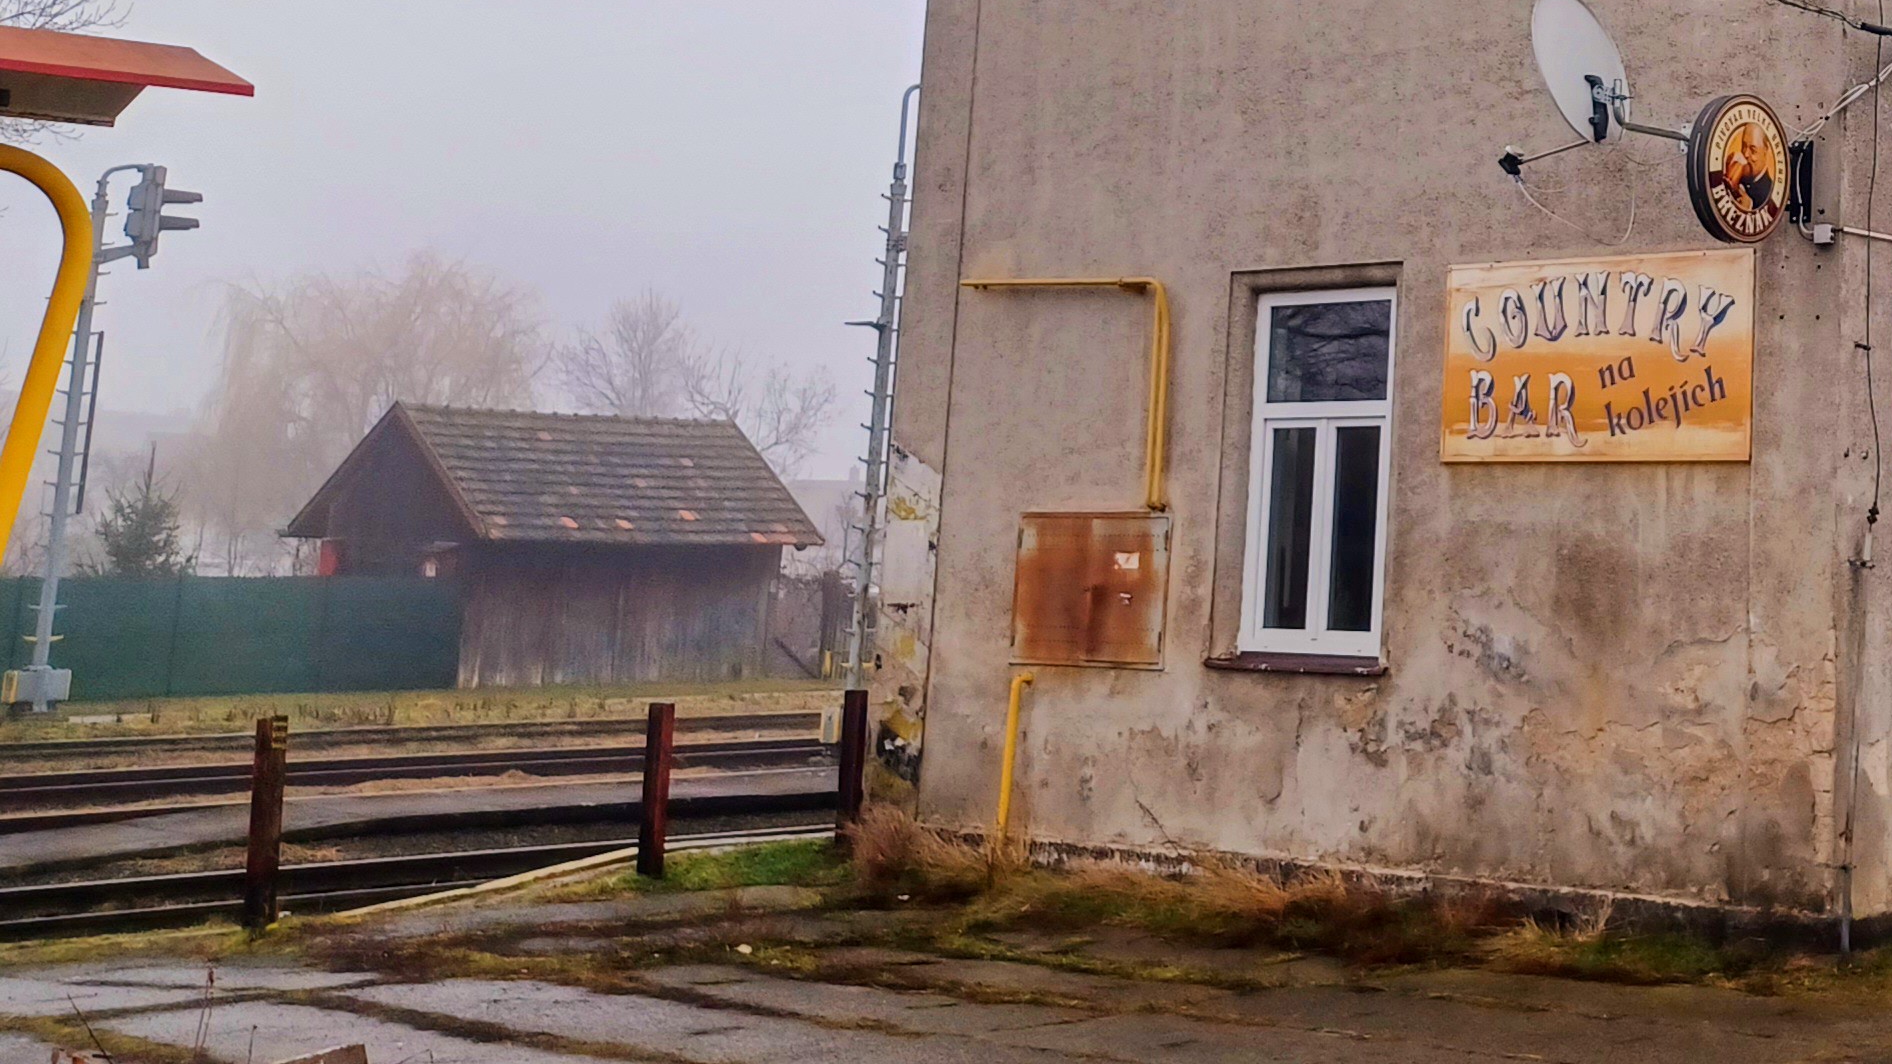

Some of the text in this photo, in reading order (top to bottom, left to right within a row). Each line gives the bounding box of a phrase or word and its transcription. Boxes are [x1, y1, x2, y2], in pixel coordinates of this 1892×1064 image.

[1460, 269, 1736, 363] COUNTRY
[1467, 369, 1588, 447] BAR
[1598, 356, 1636, 389] na
[1604, 365, 1727, 437] kolejích
